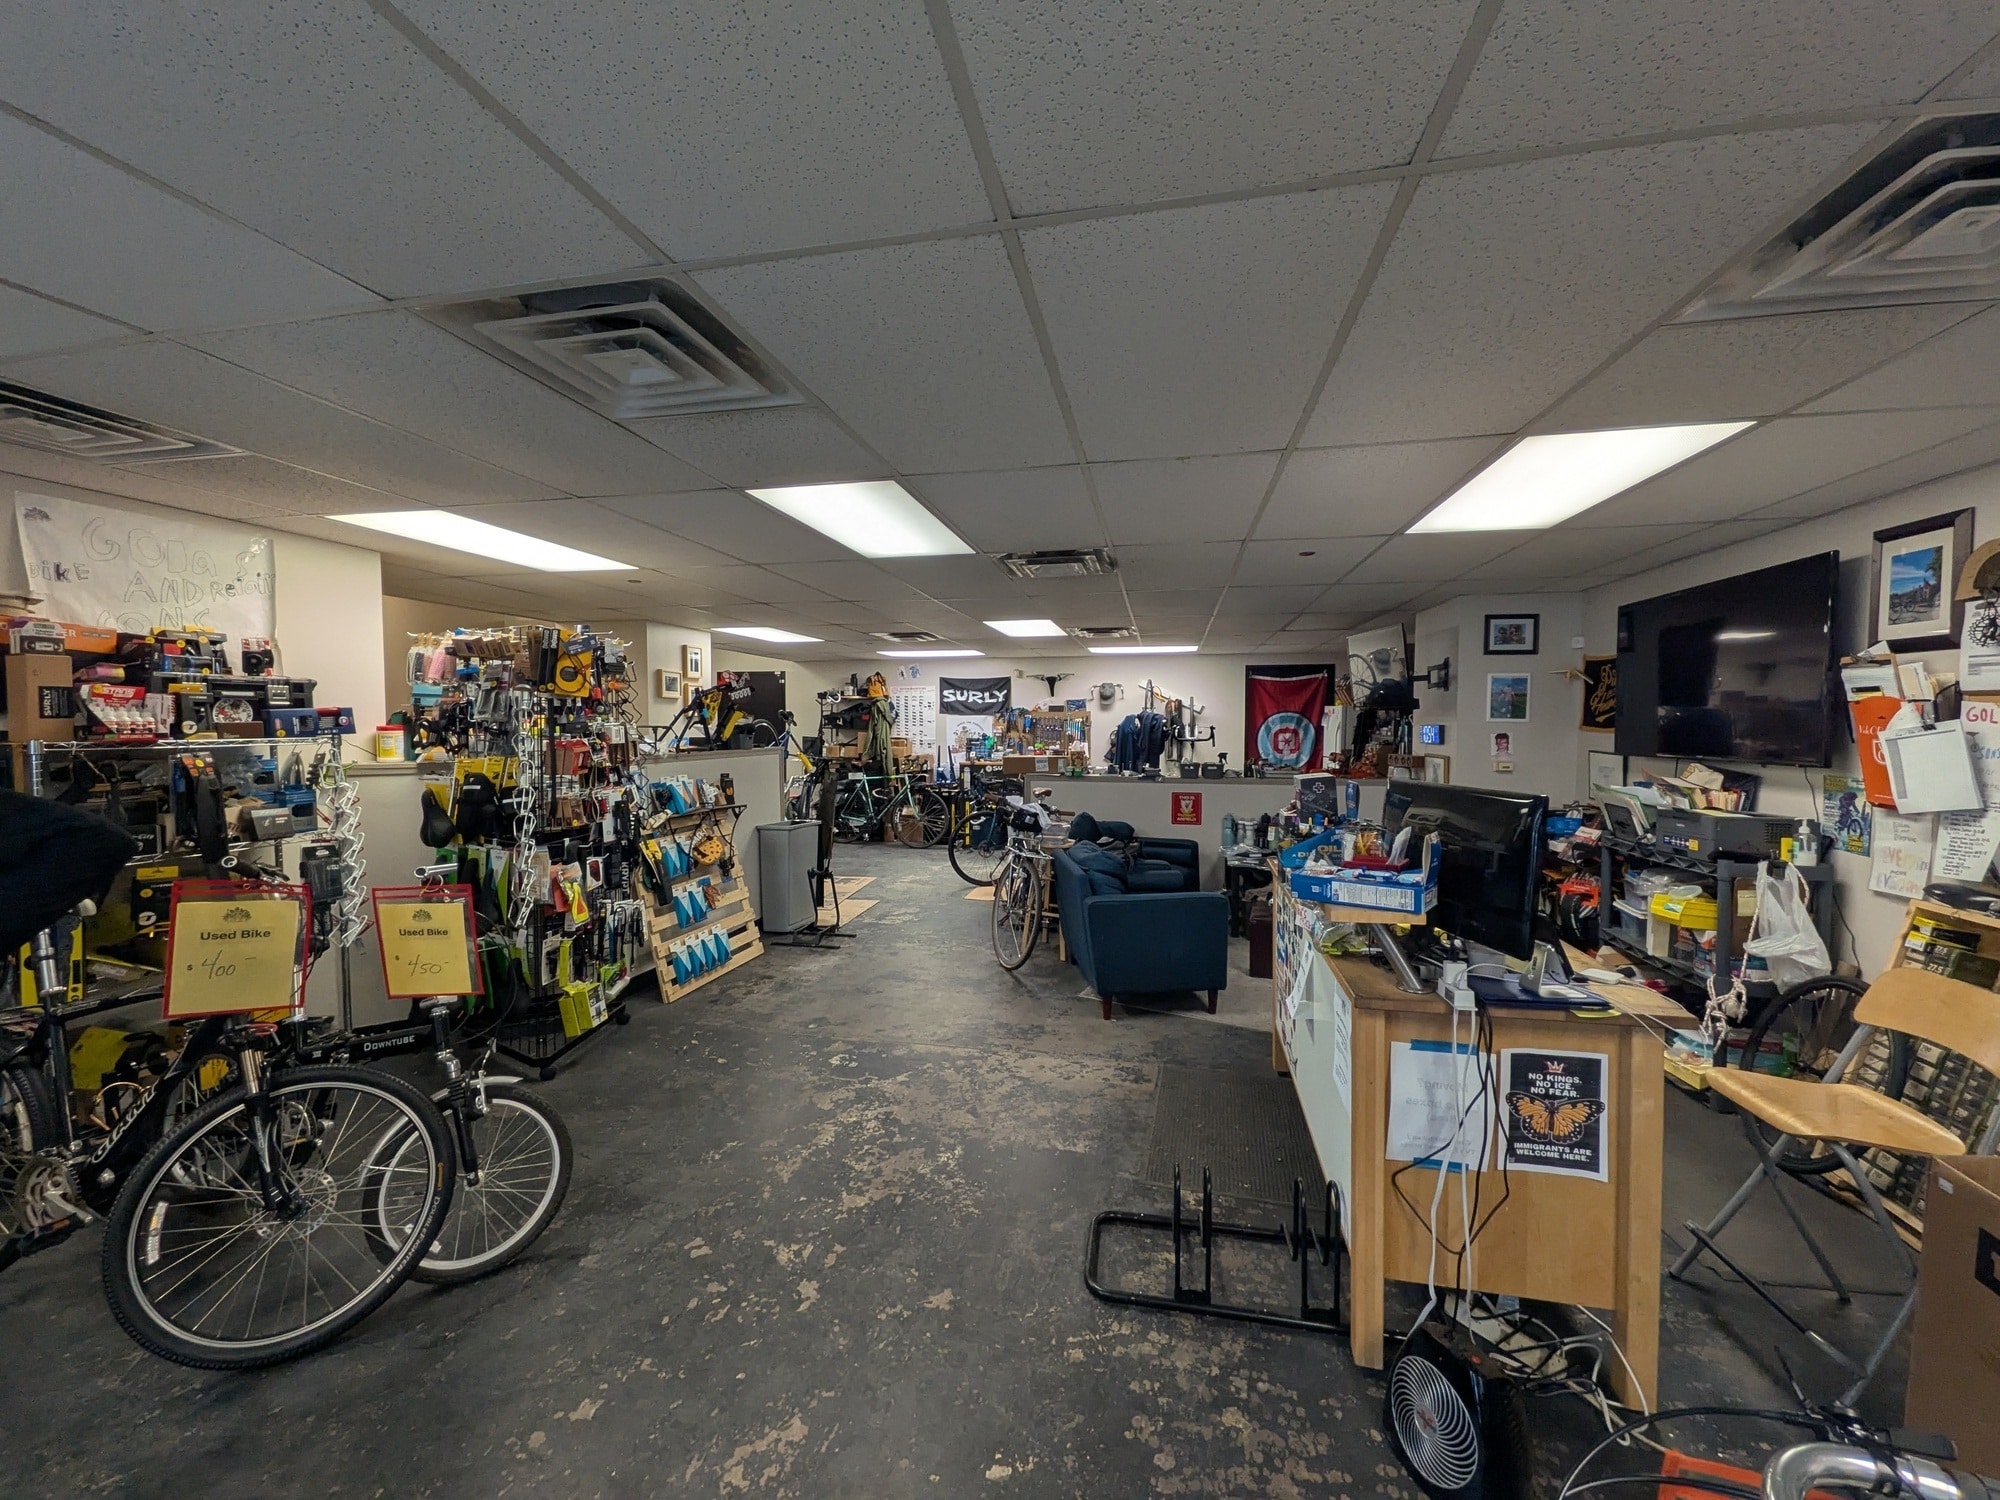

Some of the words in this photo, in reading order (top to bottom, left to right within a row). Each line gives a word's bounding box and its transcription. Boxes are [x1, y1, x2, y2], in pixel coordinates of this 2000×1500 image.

[123, 570, 205, 608] AND
[942, 688, 1008, 704] SURLY
[43, 689, 52, 717] SURLY
[200, 930, 237, 941] Used
[241, 929, 272, 939] Bike
[398, 928, 425, 937] Used
[427, 928, 449, 936] Bike
[201, 949, 237, 980] 400
[1926, 962, 1945, 975] 27.5
[1528, 1072, 1544, 1080] NO
[1546, 1074, 1582, 1084] KINGS.
[1535, 1080, 1552, 1089] NO
[1554, 1082, 1575, 1090] ICE.
[1530, 1086, 1546, 1094] NO
[1548, 1088, 1580, 1098] FEAR.
[1513, 1142, 1571, 1153] IMMIGRANTS
[1572, 1147, 1592, 1156] ARE
[1516, 1149, 1561, 1159] WELCOME
[1562, 1152, 1590, 1162] HERE.
